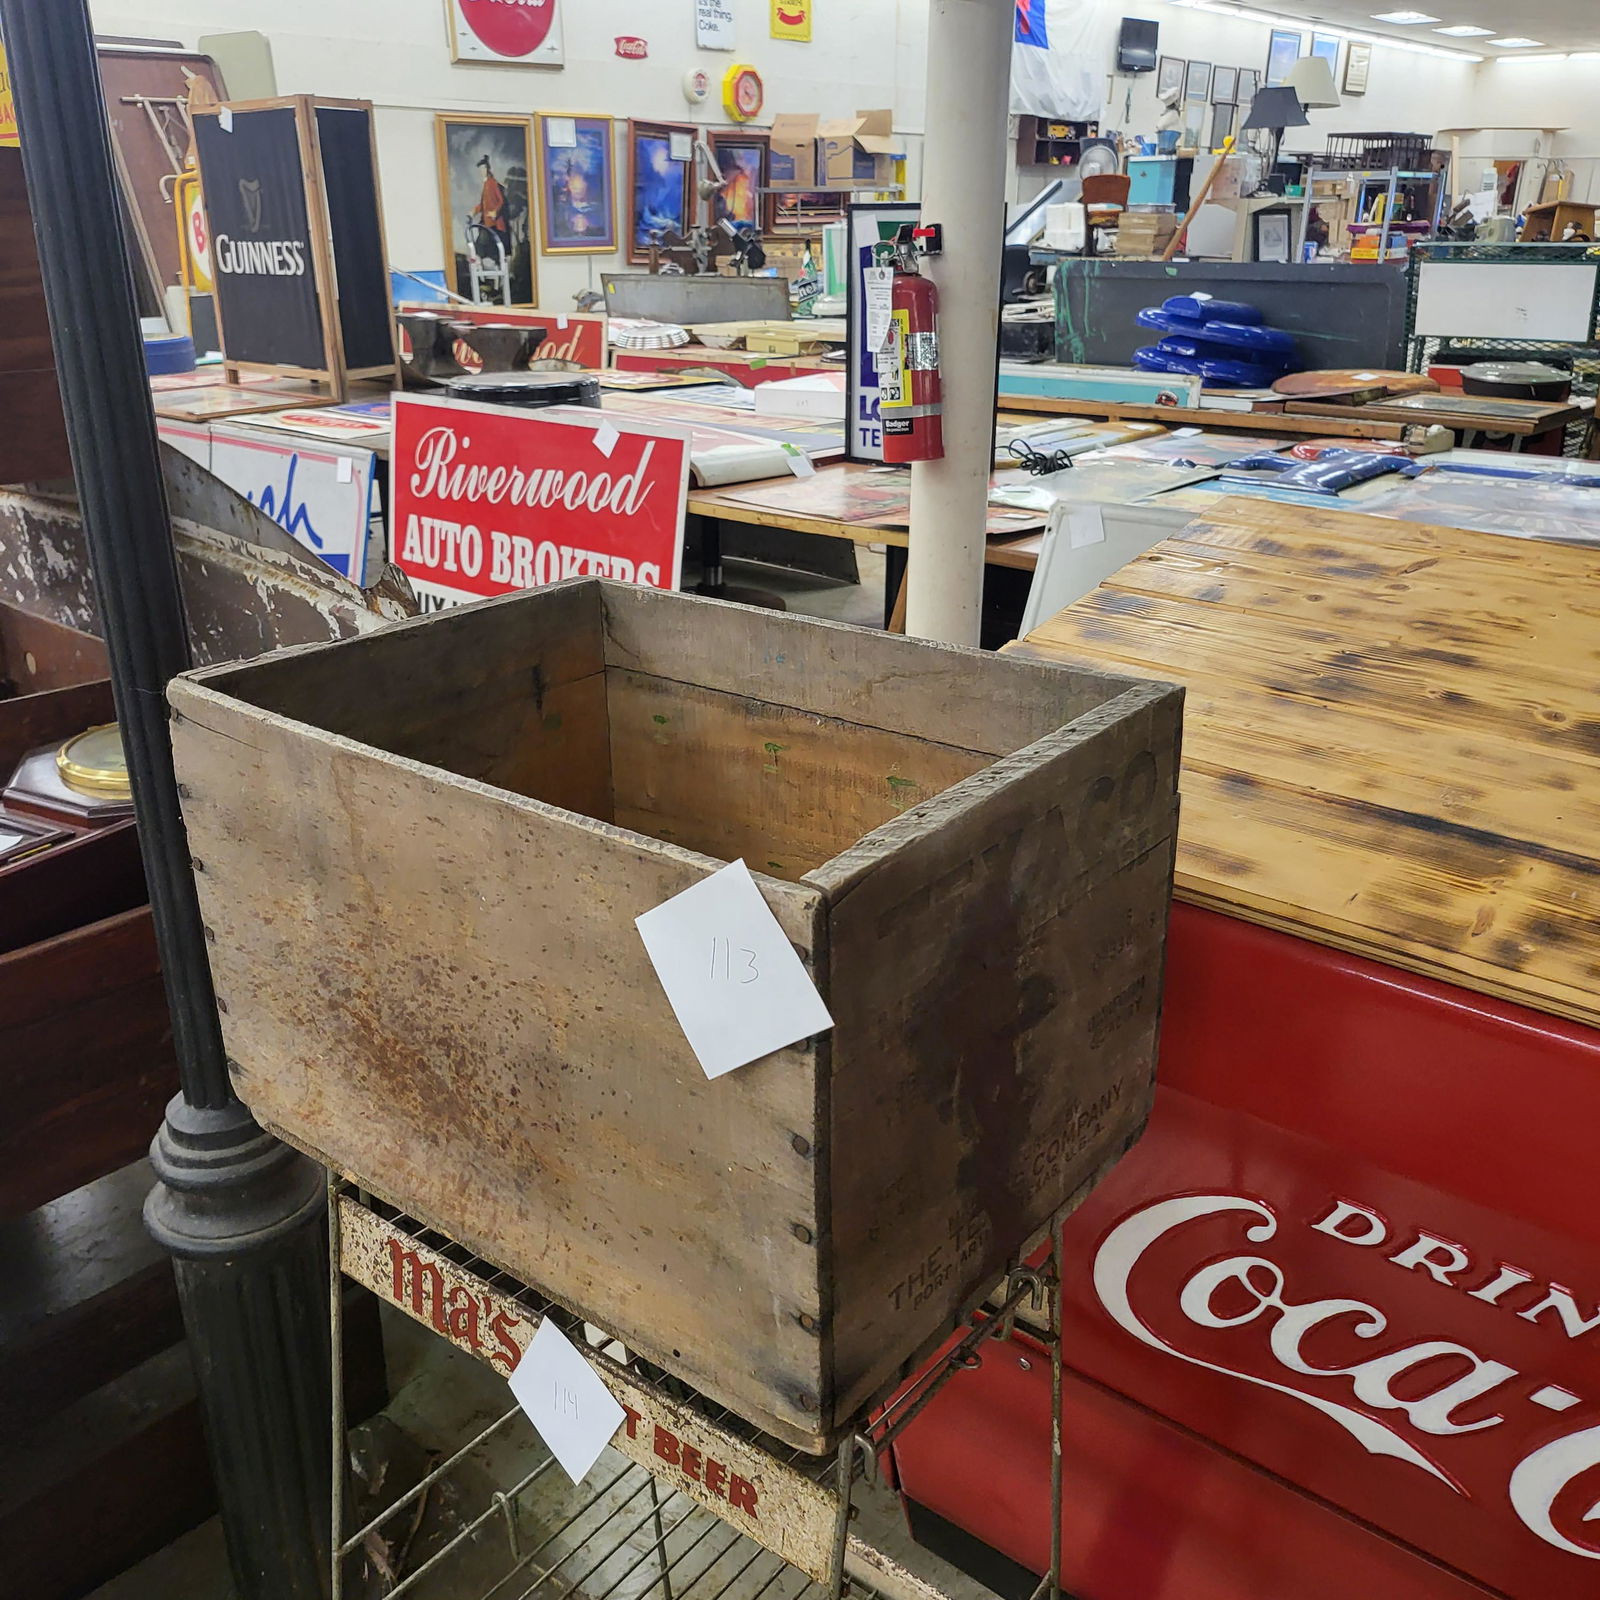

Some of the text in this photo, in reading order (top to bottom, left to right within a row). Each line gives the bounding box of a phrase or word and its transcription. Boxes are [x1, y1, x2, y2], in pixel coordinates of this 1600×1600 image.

[215, 233, 305, 276] GUINNESS
[410, 426, 656, 516] Riverwood
[402, 513, 483, 578] AUTO
[710, 936, 760, 984] 113
[887, 1245, 943, 1311] THE
[1032, 1076, 1124, 1177] COMPANY
[653, 1423, 759, 1520] BEER
